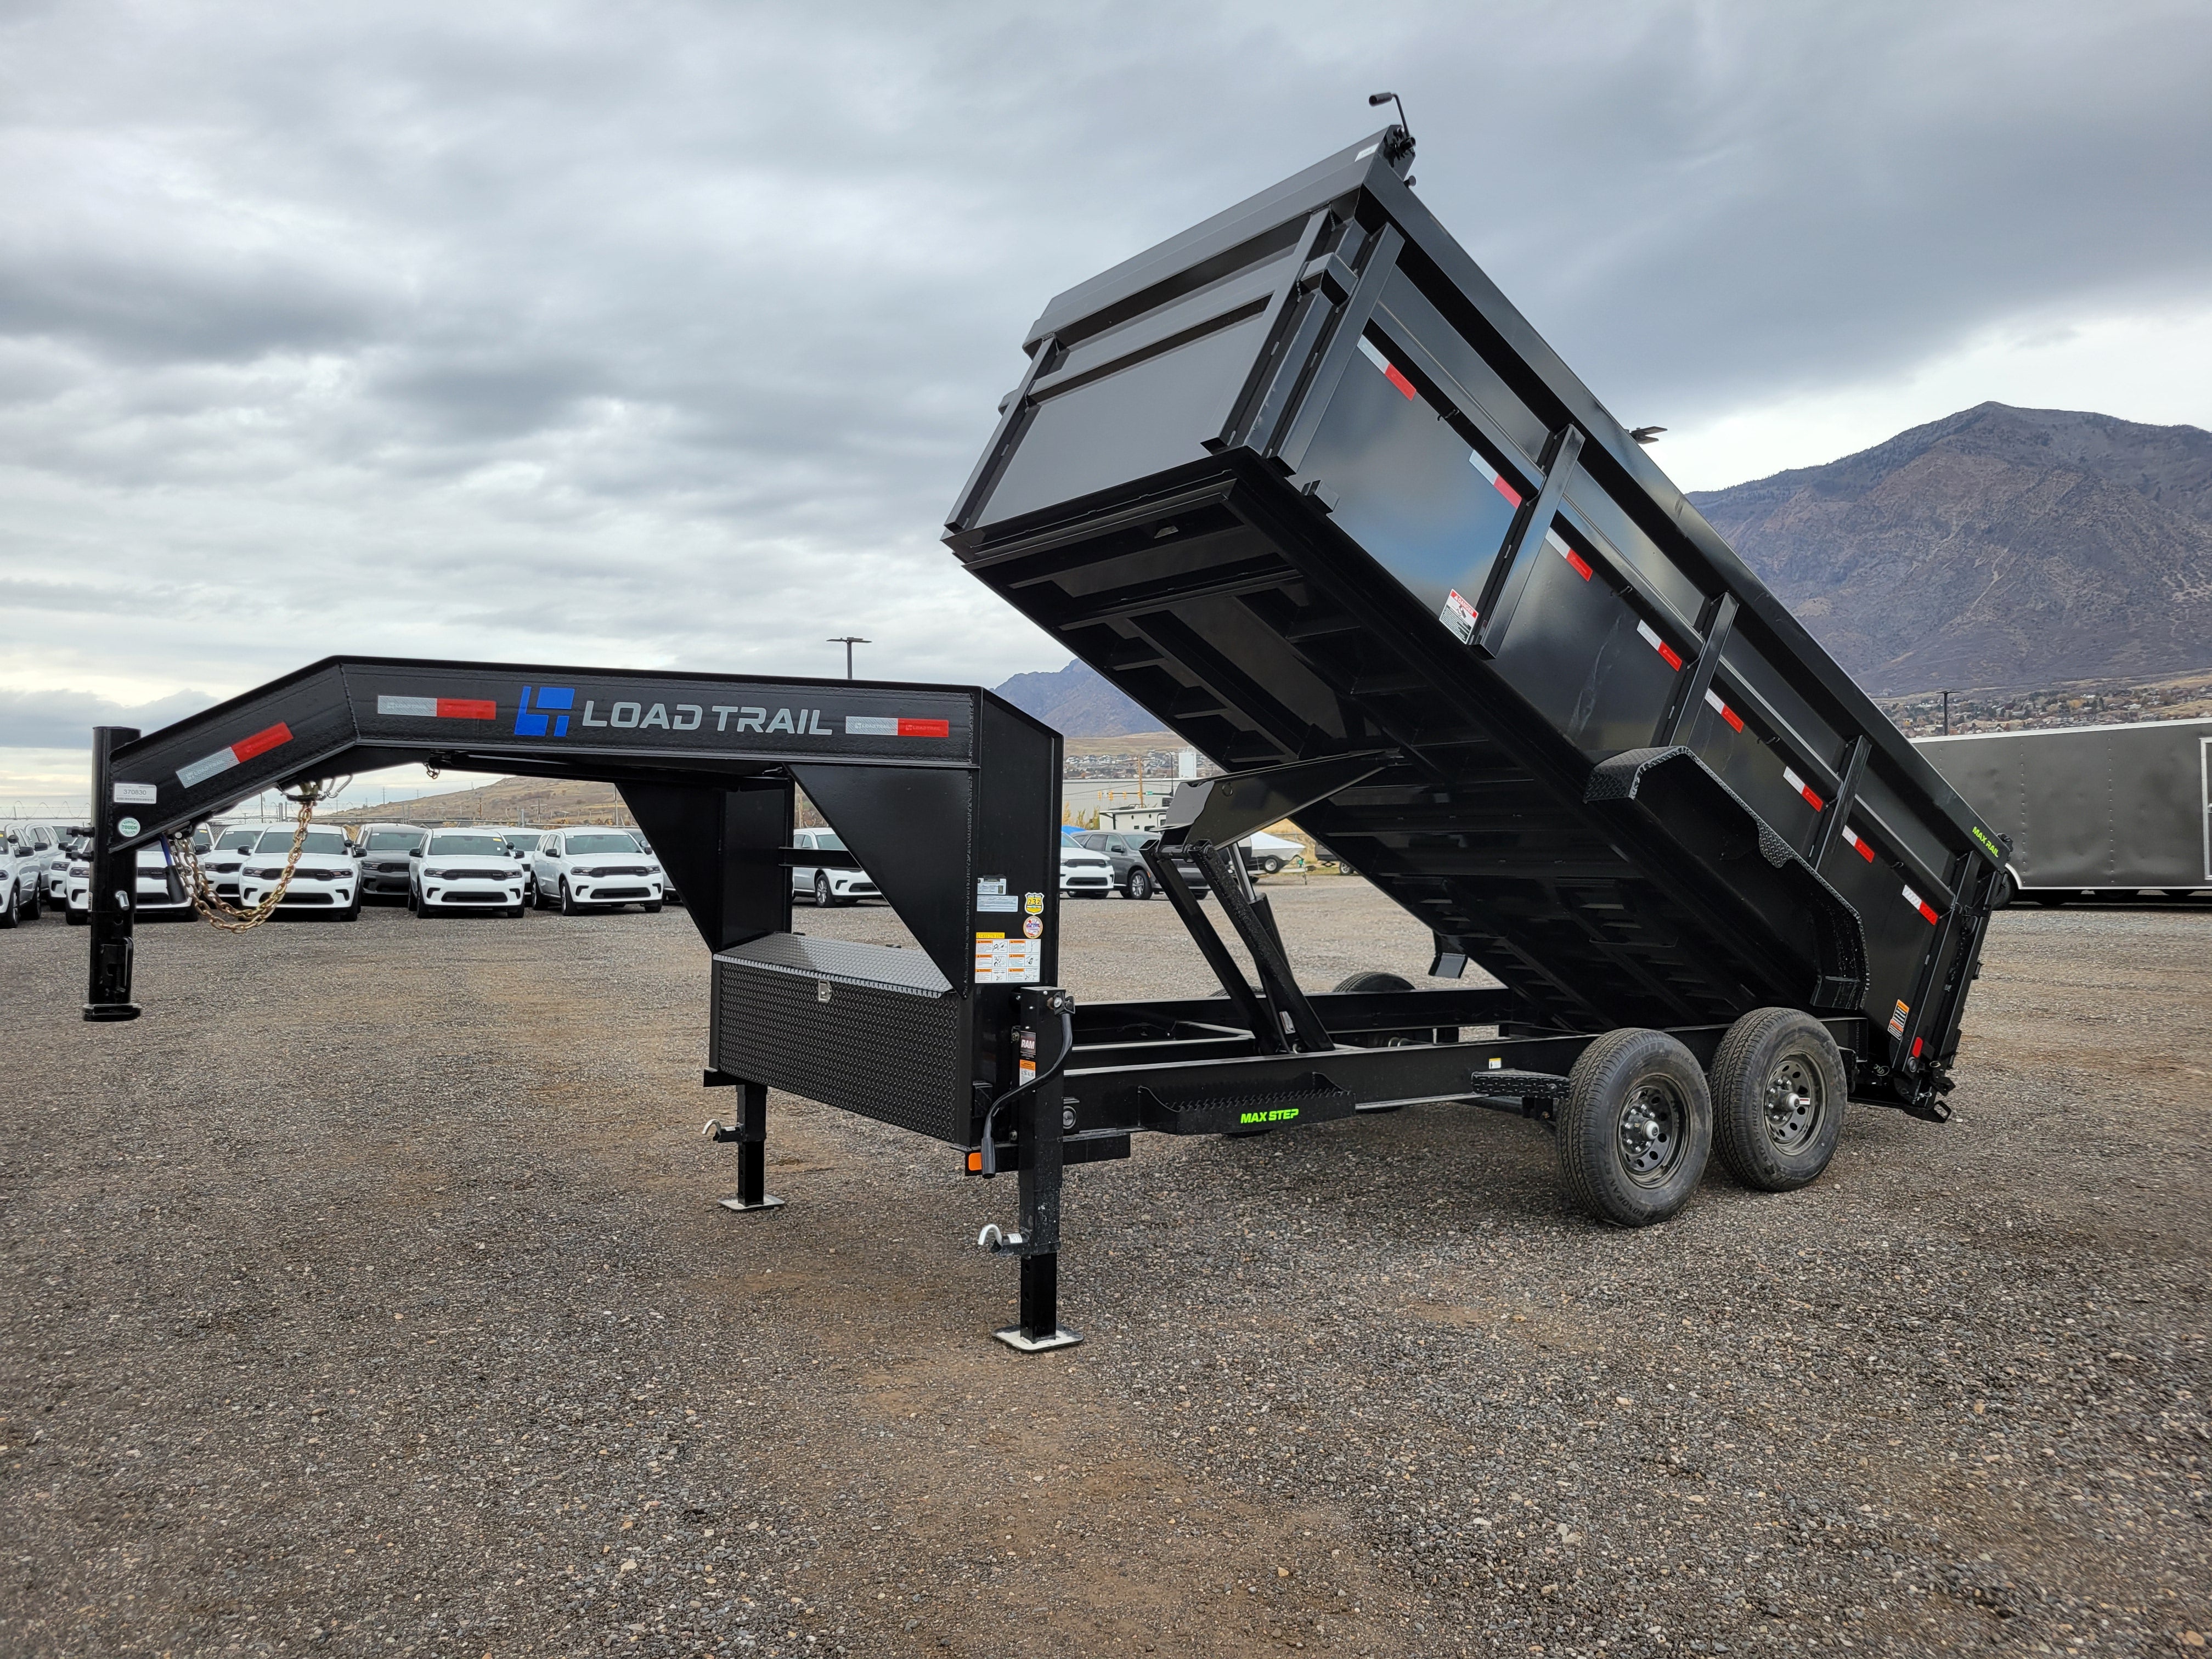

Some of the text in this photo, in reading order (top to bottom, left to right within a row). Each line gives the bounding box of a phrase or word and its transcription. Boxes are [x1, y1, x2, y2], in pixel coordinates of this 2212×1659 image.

[1457, 596, 1474, 615] DANGER
[582, 701, 703, 730] LOAD
[712, 706, 833, 735] TRAIL
[1972, 826, 1999, 857] MAX RAIL
[1021, 1039, 1035, 1049] RAM
[1240, 1109, 1299, 1124] MAX STEP
